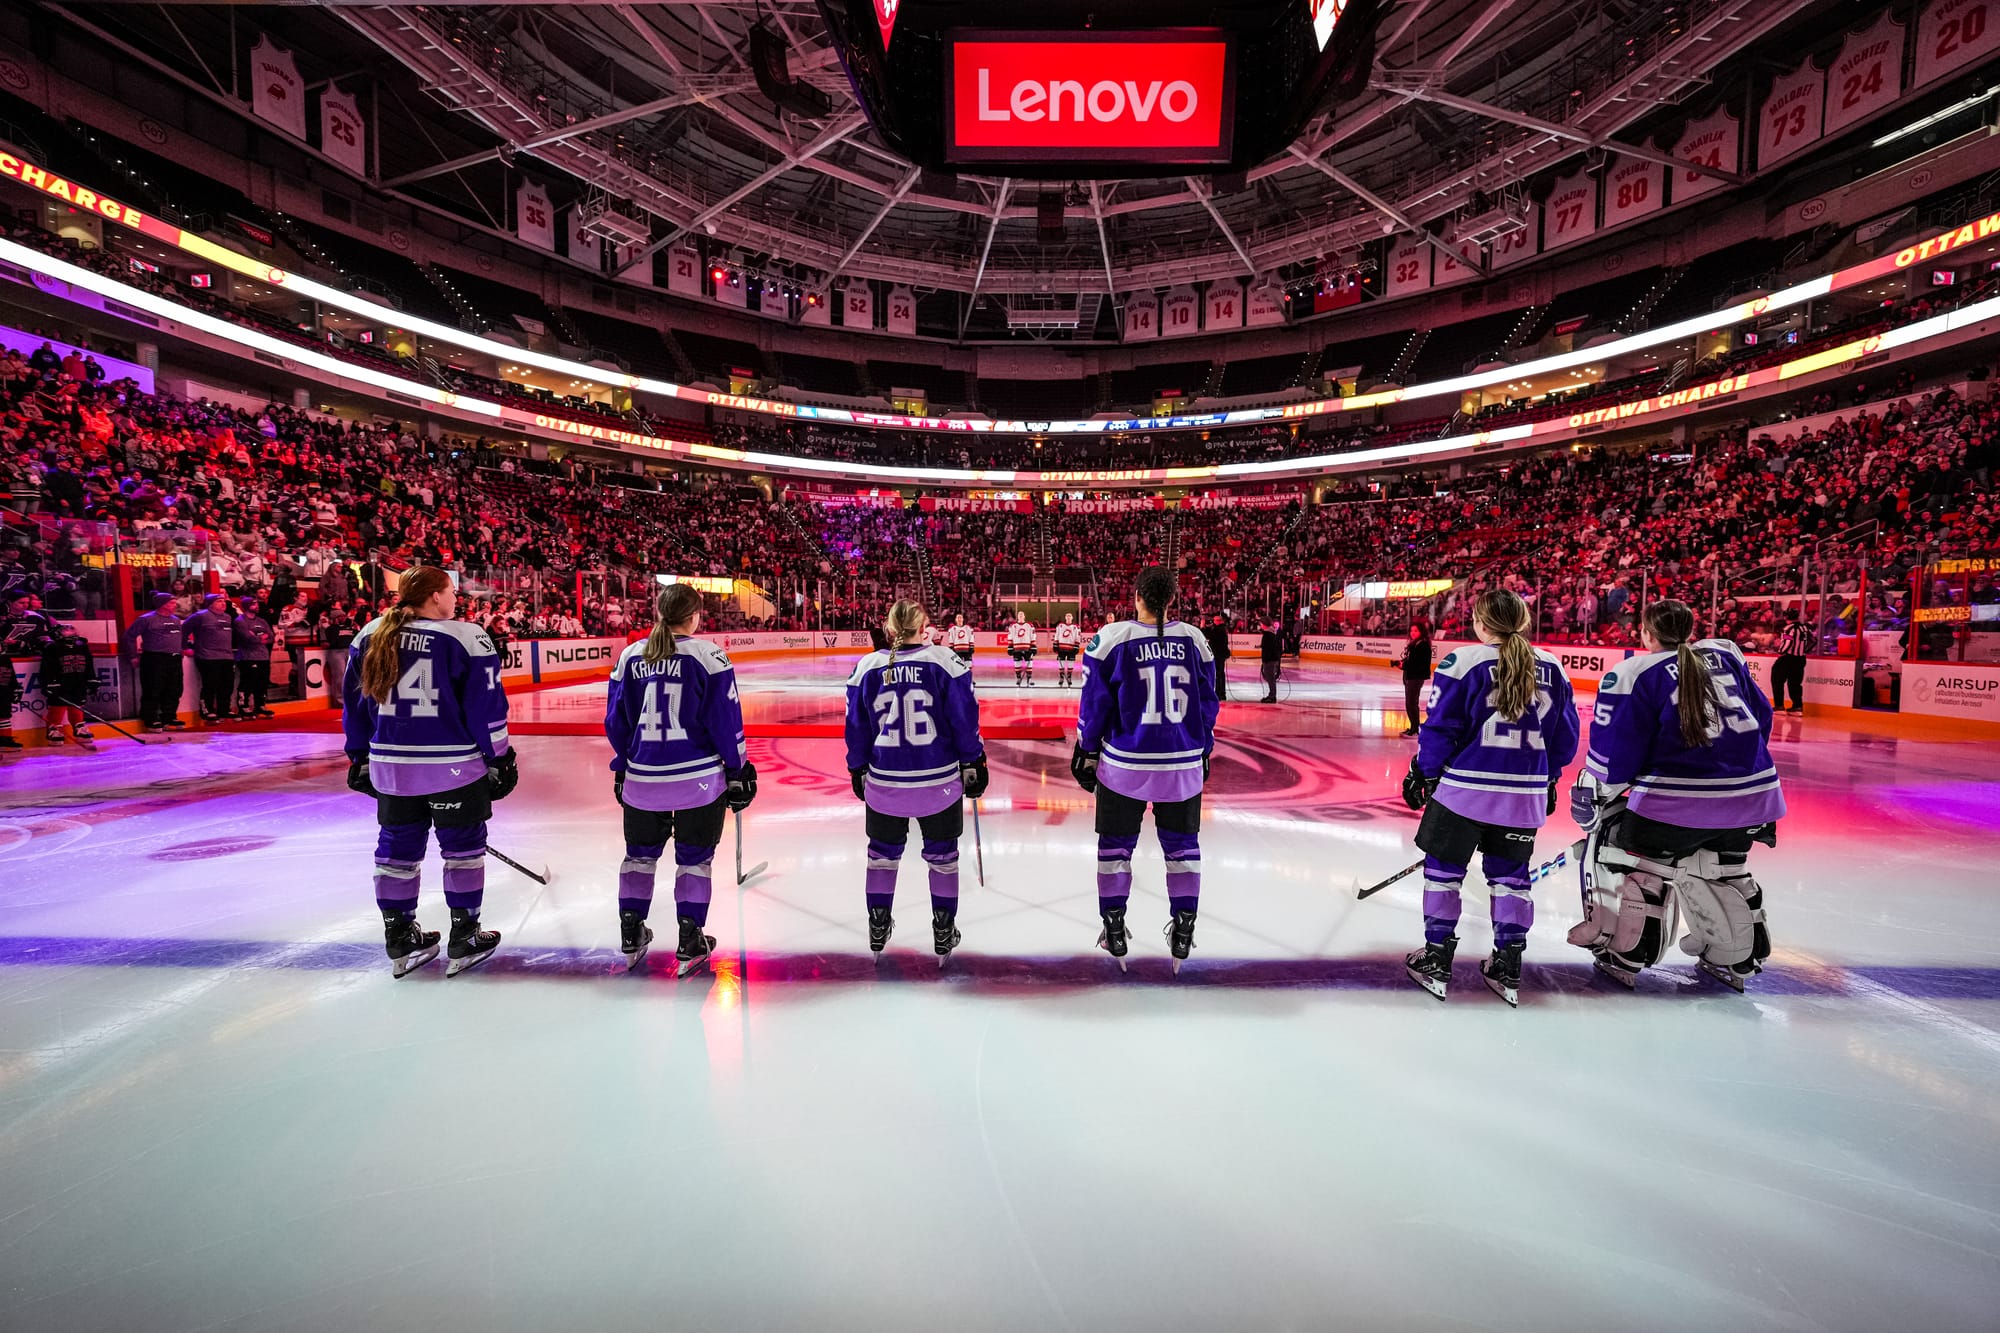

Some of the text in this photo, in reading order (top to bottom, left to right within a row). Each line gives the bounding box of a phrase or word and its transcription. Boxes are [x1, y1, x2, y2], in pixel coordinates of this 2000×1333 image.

[1936, 5, 1987, 59] 20
[1840, 40, 1890, 74] RICHTER
[1842, 61, 1883, 109] 24
[978, 68, 1198, 122] Lenovo
[330, 115, 356, 147] 25
[1773, 104, 1806, 147] 73
[0, 152, 142, 228] CHARGE
[1617, 177, 1648, 209] 80
[526, 206, 546, 228] 35
[1557, 202, 1583, 234] 77
[677, 260, 692, 277] 21
[1396, 260, 1418, 283] 32
[850, 298, 867, 313] 52
[894, 305, 910, 319] 24
[1214, 301, 1233, 319] 14
[1133, 312, 1149, 330] 14
[1171, 307, 1188, 325] 10
[707, 393, 769, 411] OTTAWA
[1569, 374, 1750, 428] OTTAWA CHARGE
[536, 415, 673, 450] OTTAWA CHARGE
[1261, 437, 1277, 445] Club
[1040, 470, 1152, 480] OTTAWA CHARGE
[858, 496, 896, 508] THE
[935, 498, 1017, 511] BUFFALO
[1064, 499, 1155, 513] BROTHERS
[1189, 496, 1239, 509] ZONE
[1389, 582, 1426, 590] OTTAWA
[399, 631, 434, 653] TRIE
[1135, 641, 1185, 662] JAQUES
[546, 647, 612, 664] NUCOR
[1561, 655, 1604, 671] PEPSI
[1936, 677, 1999, 691] AIRSUP
[1138, 665, 1191, 724] 16
[1961, 700, 1982, 708] Aerosol
[638, 683, 688, 741] 41
[873, 689, 937, 747] 26
